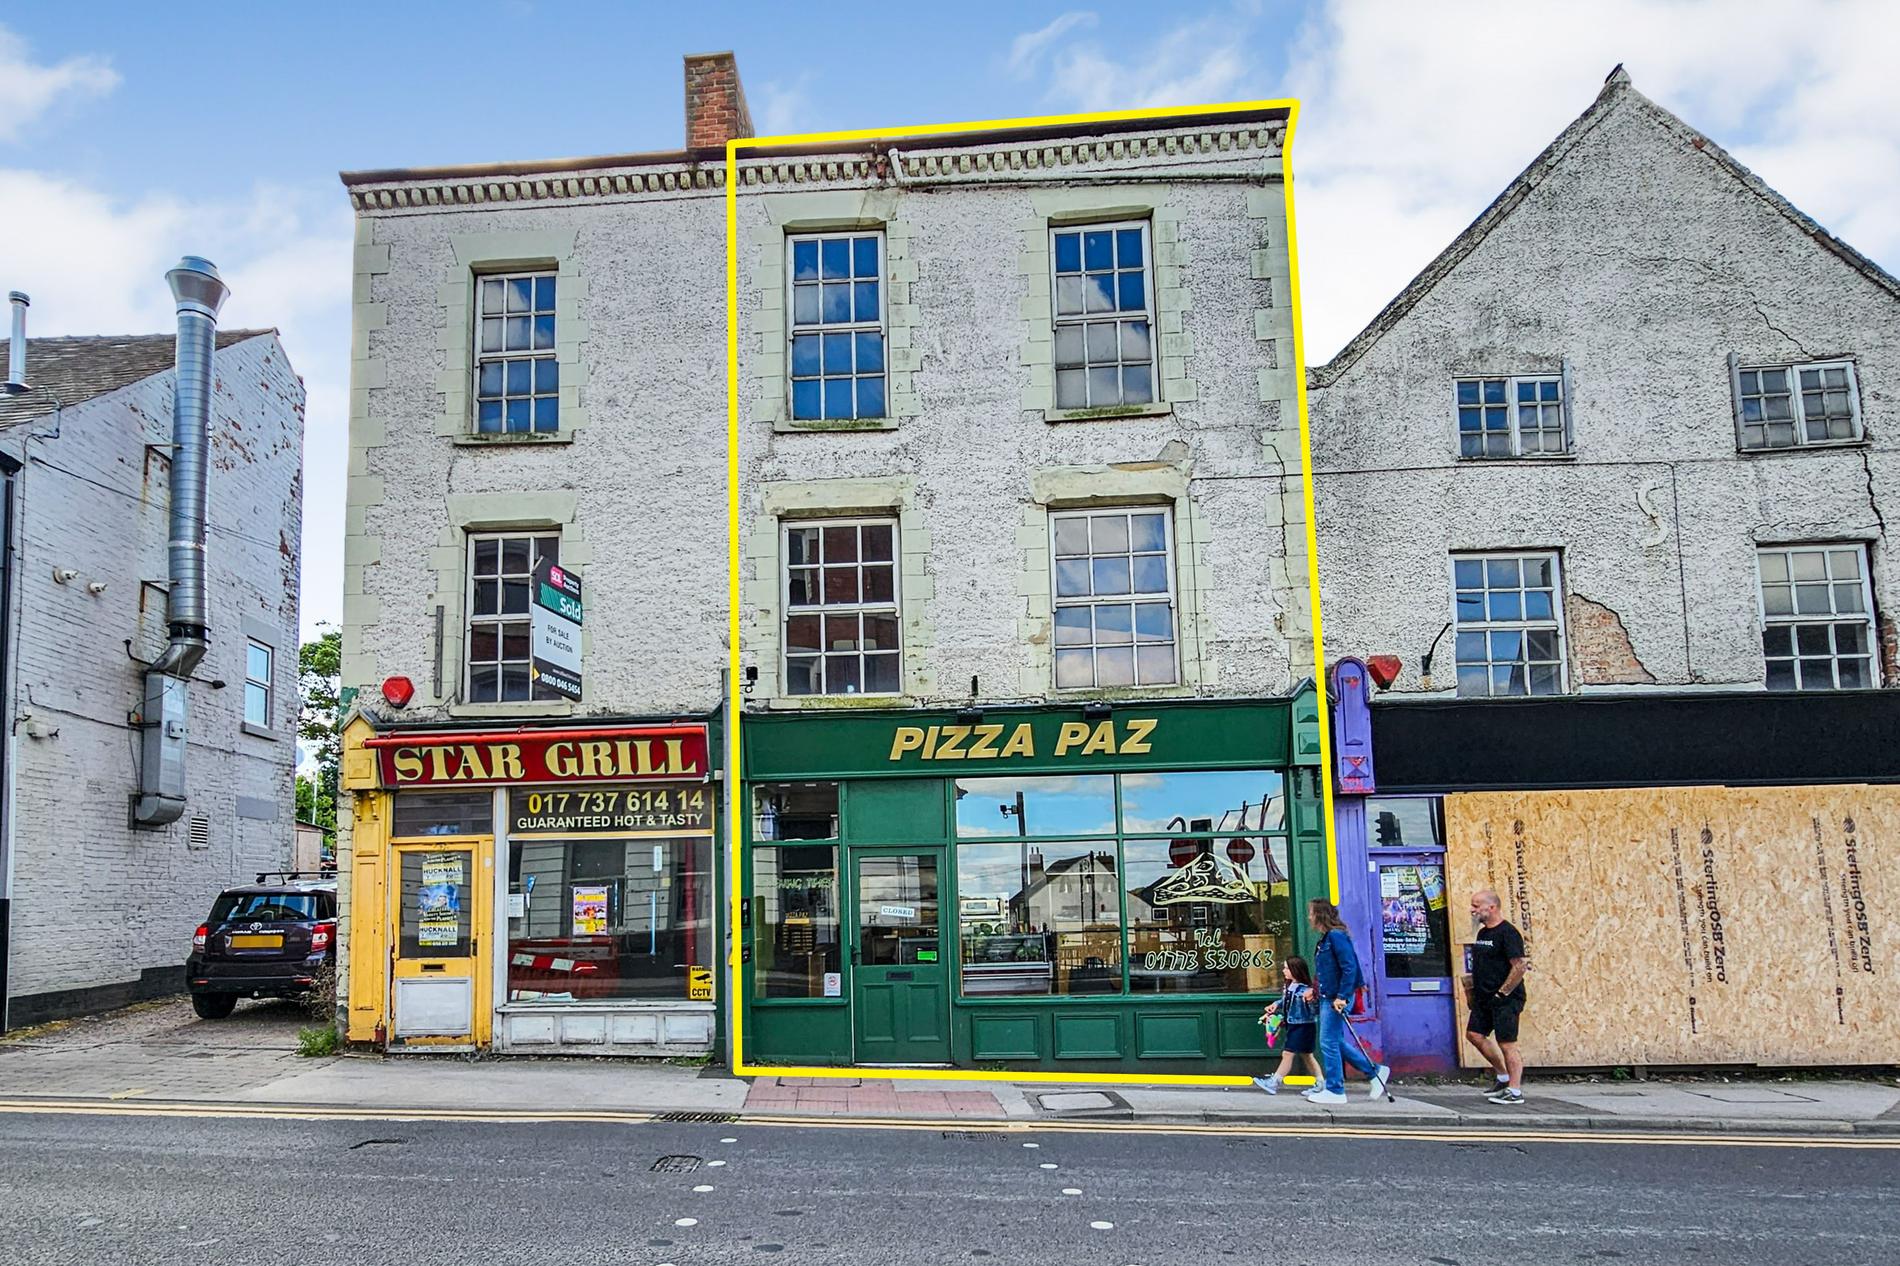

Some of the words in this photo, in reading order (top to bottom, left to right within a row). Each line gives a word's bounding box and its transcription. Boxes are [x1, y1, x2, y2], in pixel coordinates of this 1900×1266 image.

[560, 597, 580, 620] Sold
[547, 624, 557, 635] FOR
[558, 629, 569, 640] SALE
[546, 636, 552, 646] BY
[553, 639, 573, 654] AUCTION
[889, 723, 1035, 760] PIZZA
[1054, 719, 1158, 756] PAZ
[393, 744, 525, 782] STAR
[545, 739, 697, 777] GRILL
[528, 793, 570, 814] 017
[578, 791, 619, 813] 737
[626, 790, 669, 812] 614
[677, 789, 705, 810] 14
[517, 815, 611, 829] GUARANTEED
[614, 814, 643, 827] HOT
[646, 814, 656, 826] &
[660, 813, 704, 826] TASTY
[423, 866, 462, 874] HUCKNALL
[882, 907, 913, 916] CLOSED
[1194, 928, 1222, 948] Tel
[1145, 950, 1199, 971] 01773
[1204, 949, 1275, 970] 530863
[1714, 945, 1726, 983] Zero
[1859, 936, 1873, 973] Zero
[1707, 971, 1713, 983] on
[692, 988, 711, 997] CCTV
